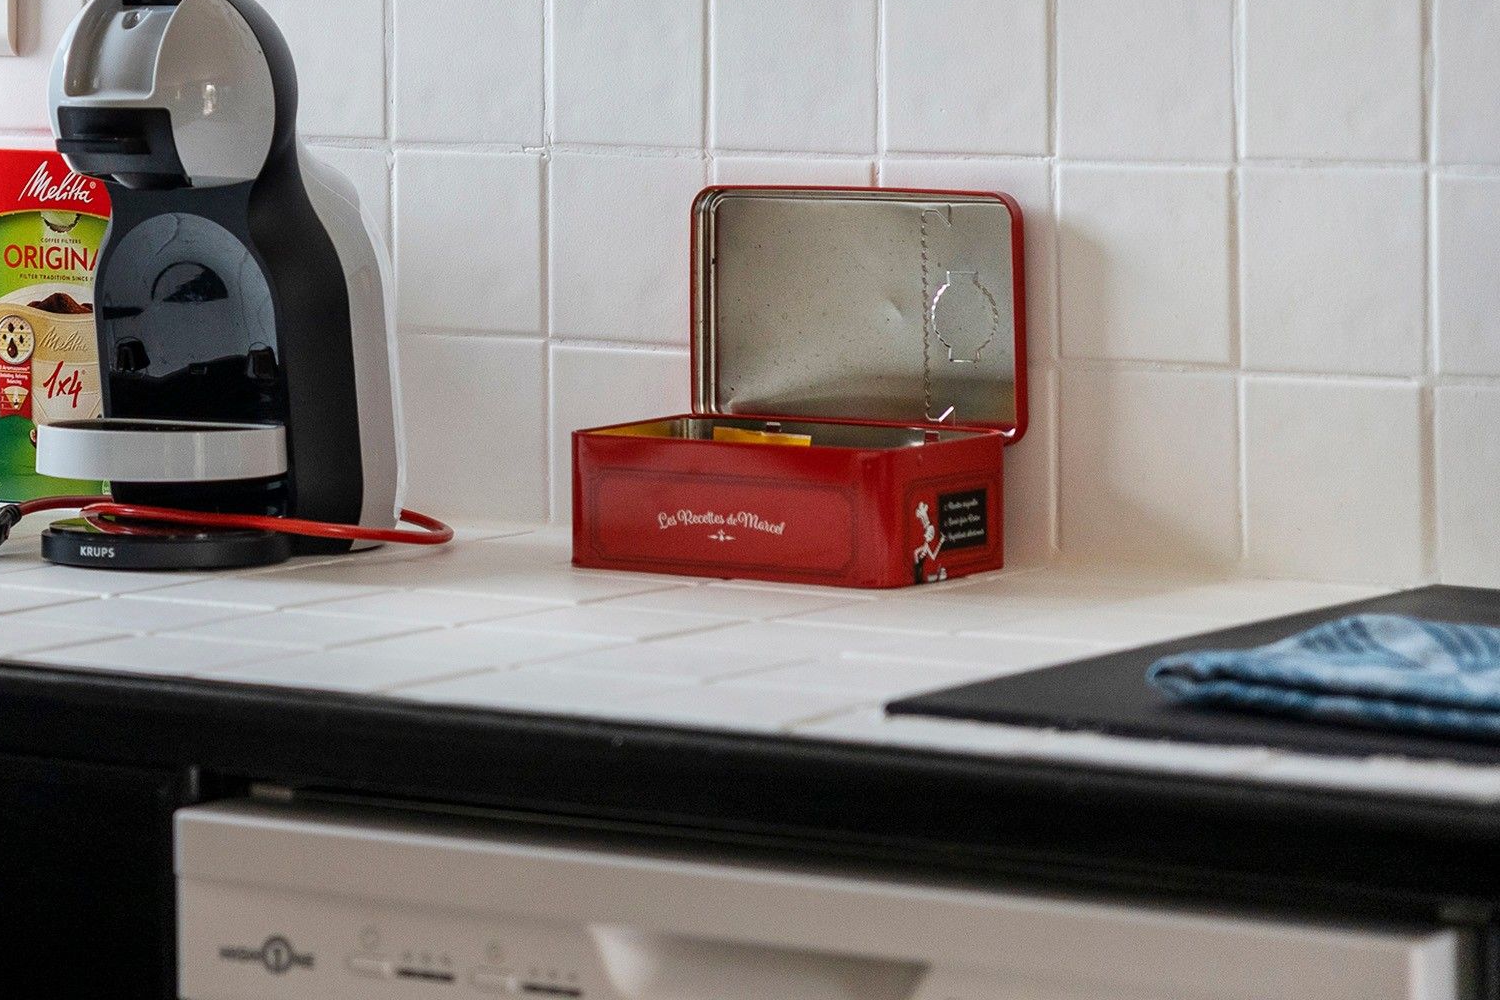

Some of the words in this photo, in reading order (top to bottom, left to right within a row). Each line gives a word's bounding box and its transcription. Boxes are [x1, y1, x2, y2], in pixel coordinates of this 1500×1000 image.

[43, 360, 83, 409] 1x4
[658, 511, 677, 530] Les
[677, 509, 725, 526] Recettes
[726, 513, 738, 526] de
[737, 511, 786, 535] Marcel
[80, 546, 115, 558] KRUPS
